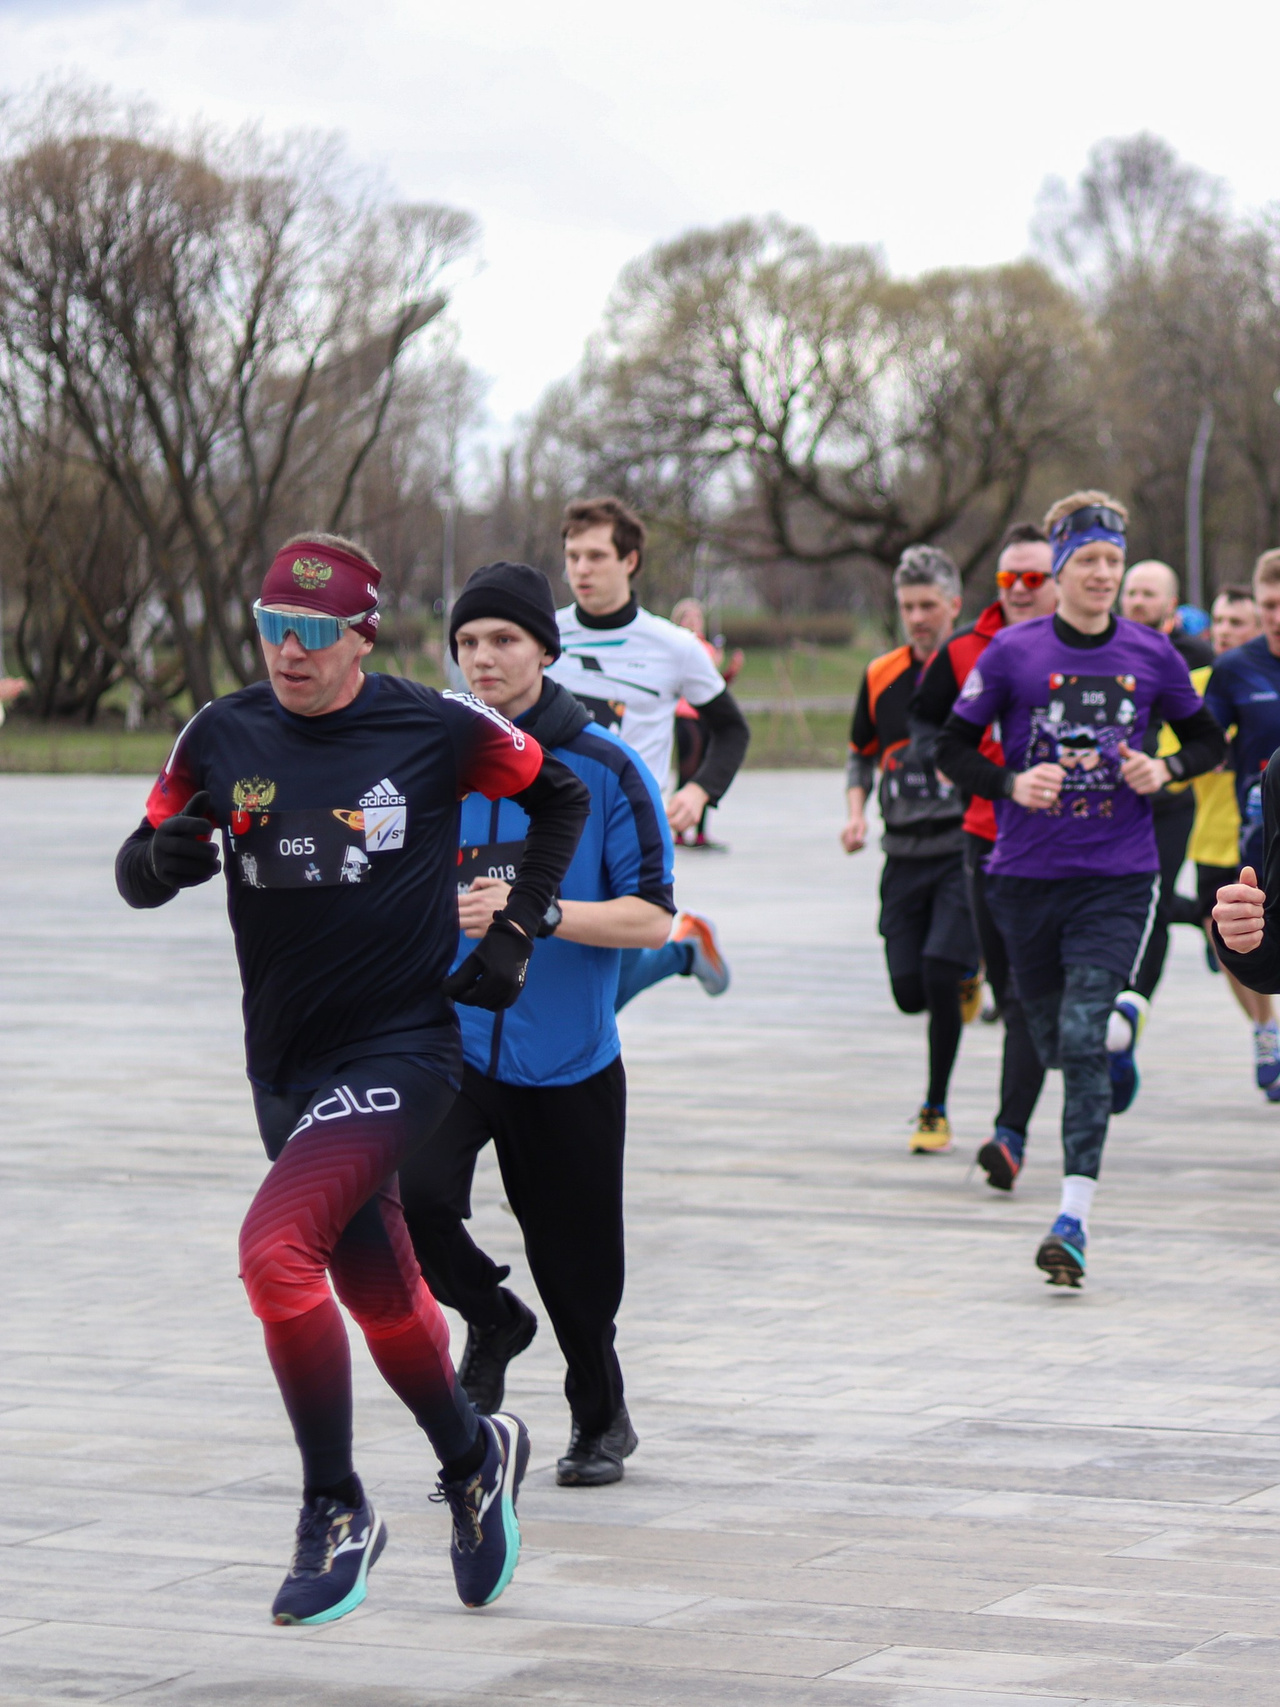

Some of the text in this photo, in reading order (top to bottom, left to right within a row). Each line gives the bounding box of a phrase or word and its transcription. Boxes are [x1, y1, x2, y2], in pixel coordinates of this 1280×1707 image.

[1082, 691, 1106, 705] 105
[358, 795, 406, 807] adidas
[279, 837, 315, 856] 065
[488, 864, 517, 881] 018
